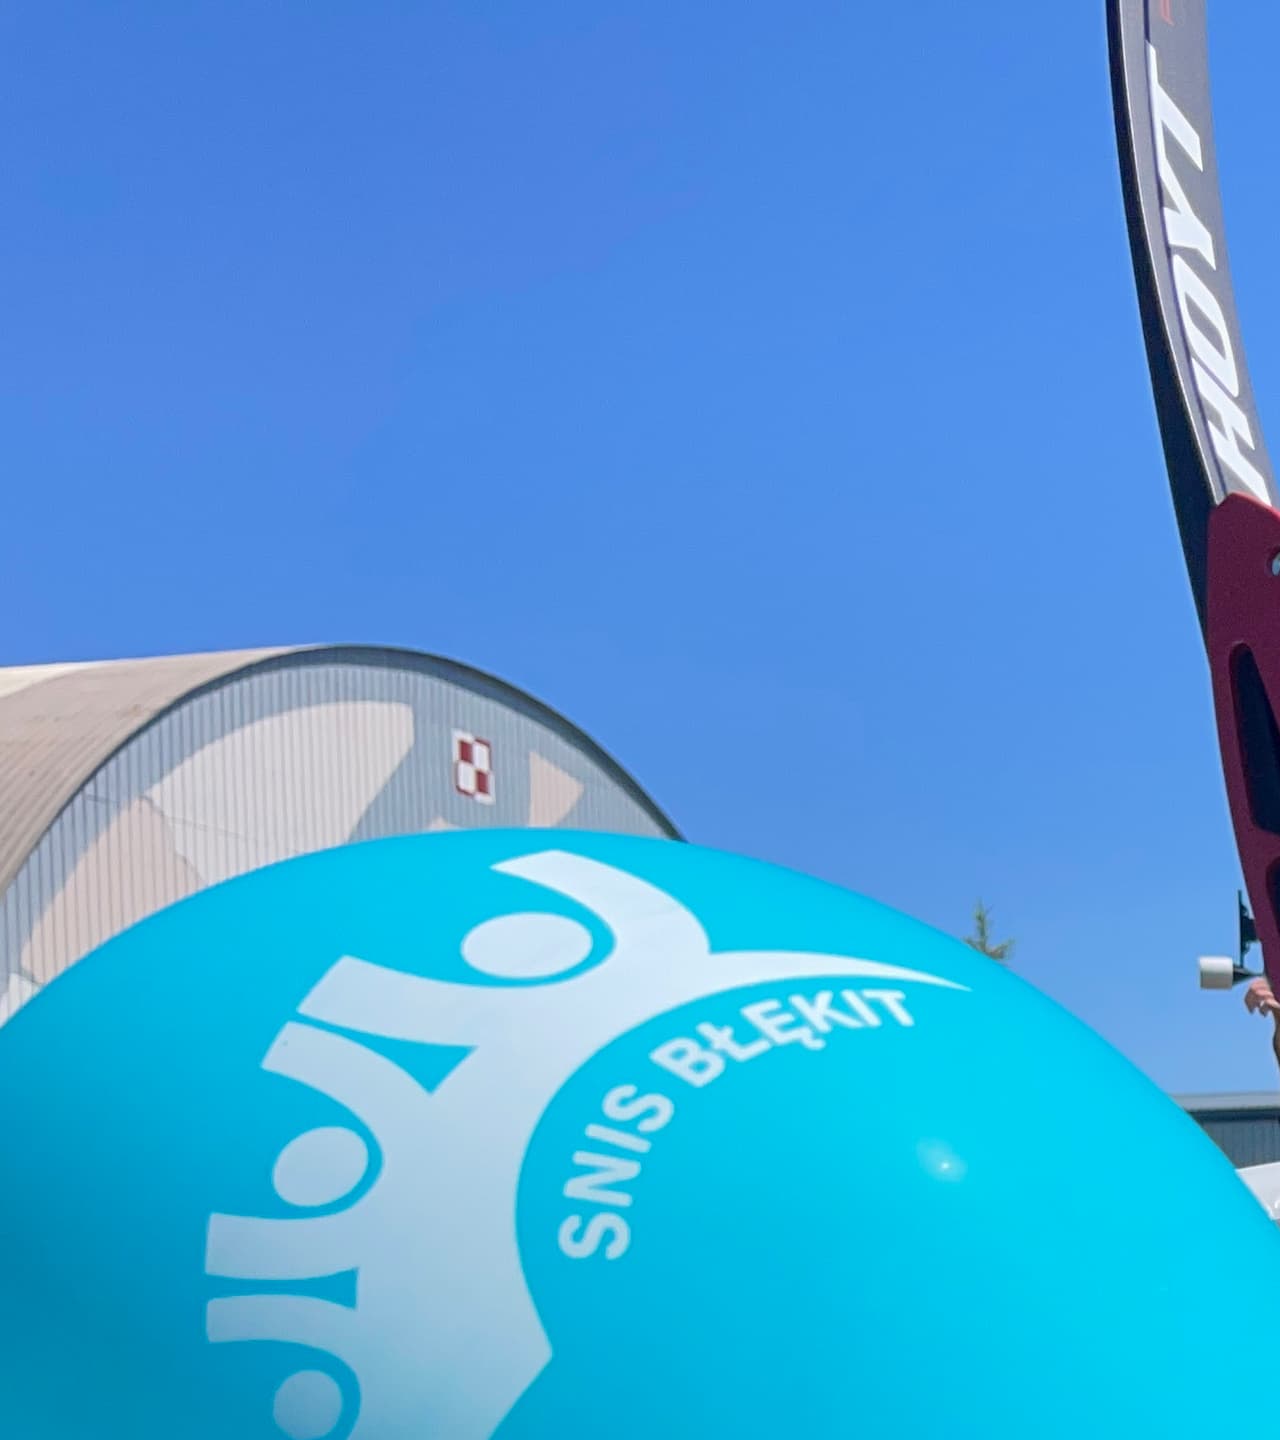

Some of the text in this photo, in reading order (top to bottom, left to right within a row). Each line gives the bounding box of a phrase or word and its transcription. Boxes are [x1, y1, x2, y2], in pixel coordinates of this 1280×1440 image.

[1145, 40, 1272, 508] HOYT
[557, 987, 916, 1261] SNIS BŁĘKIT
